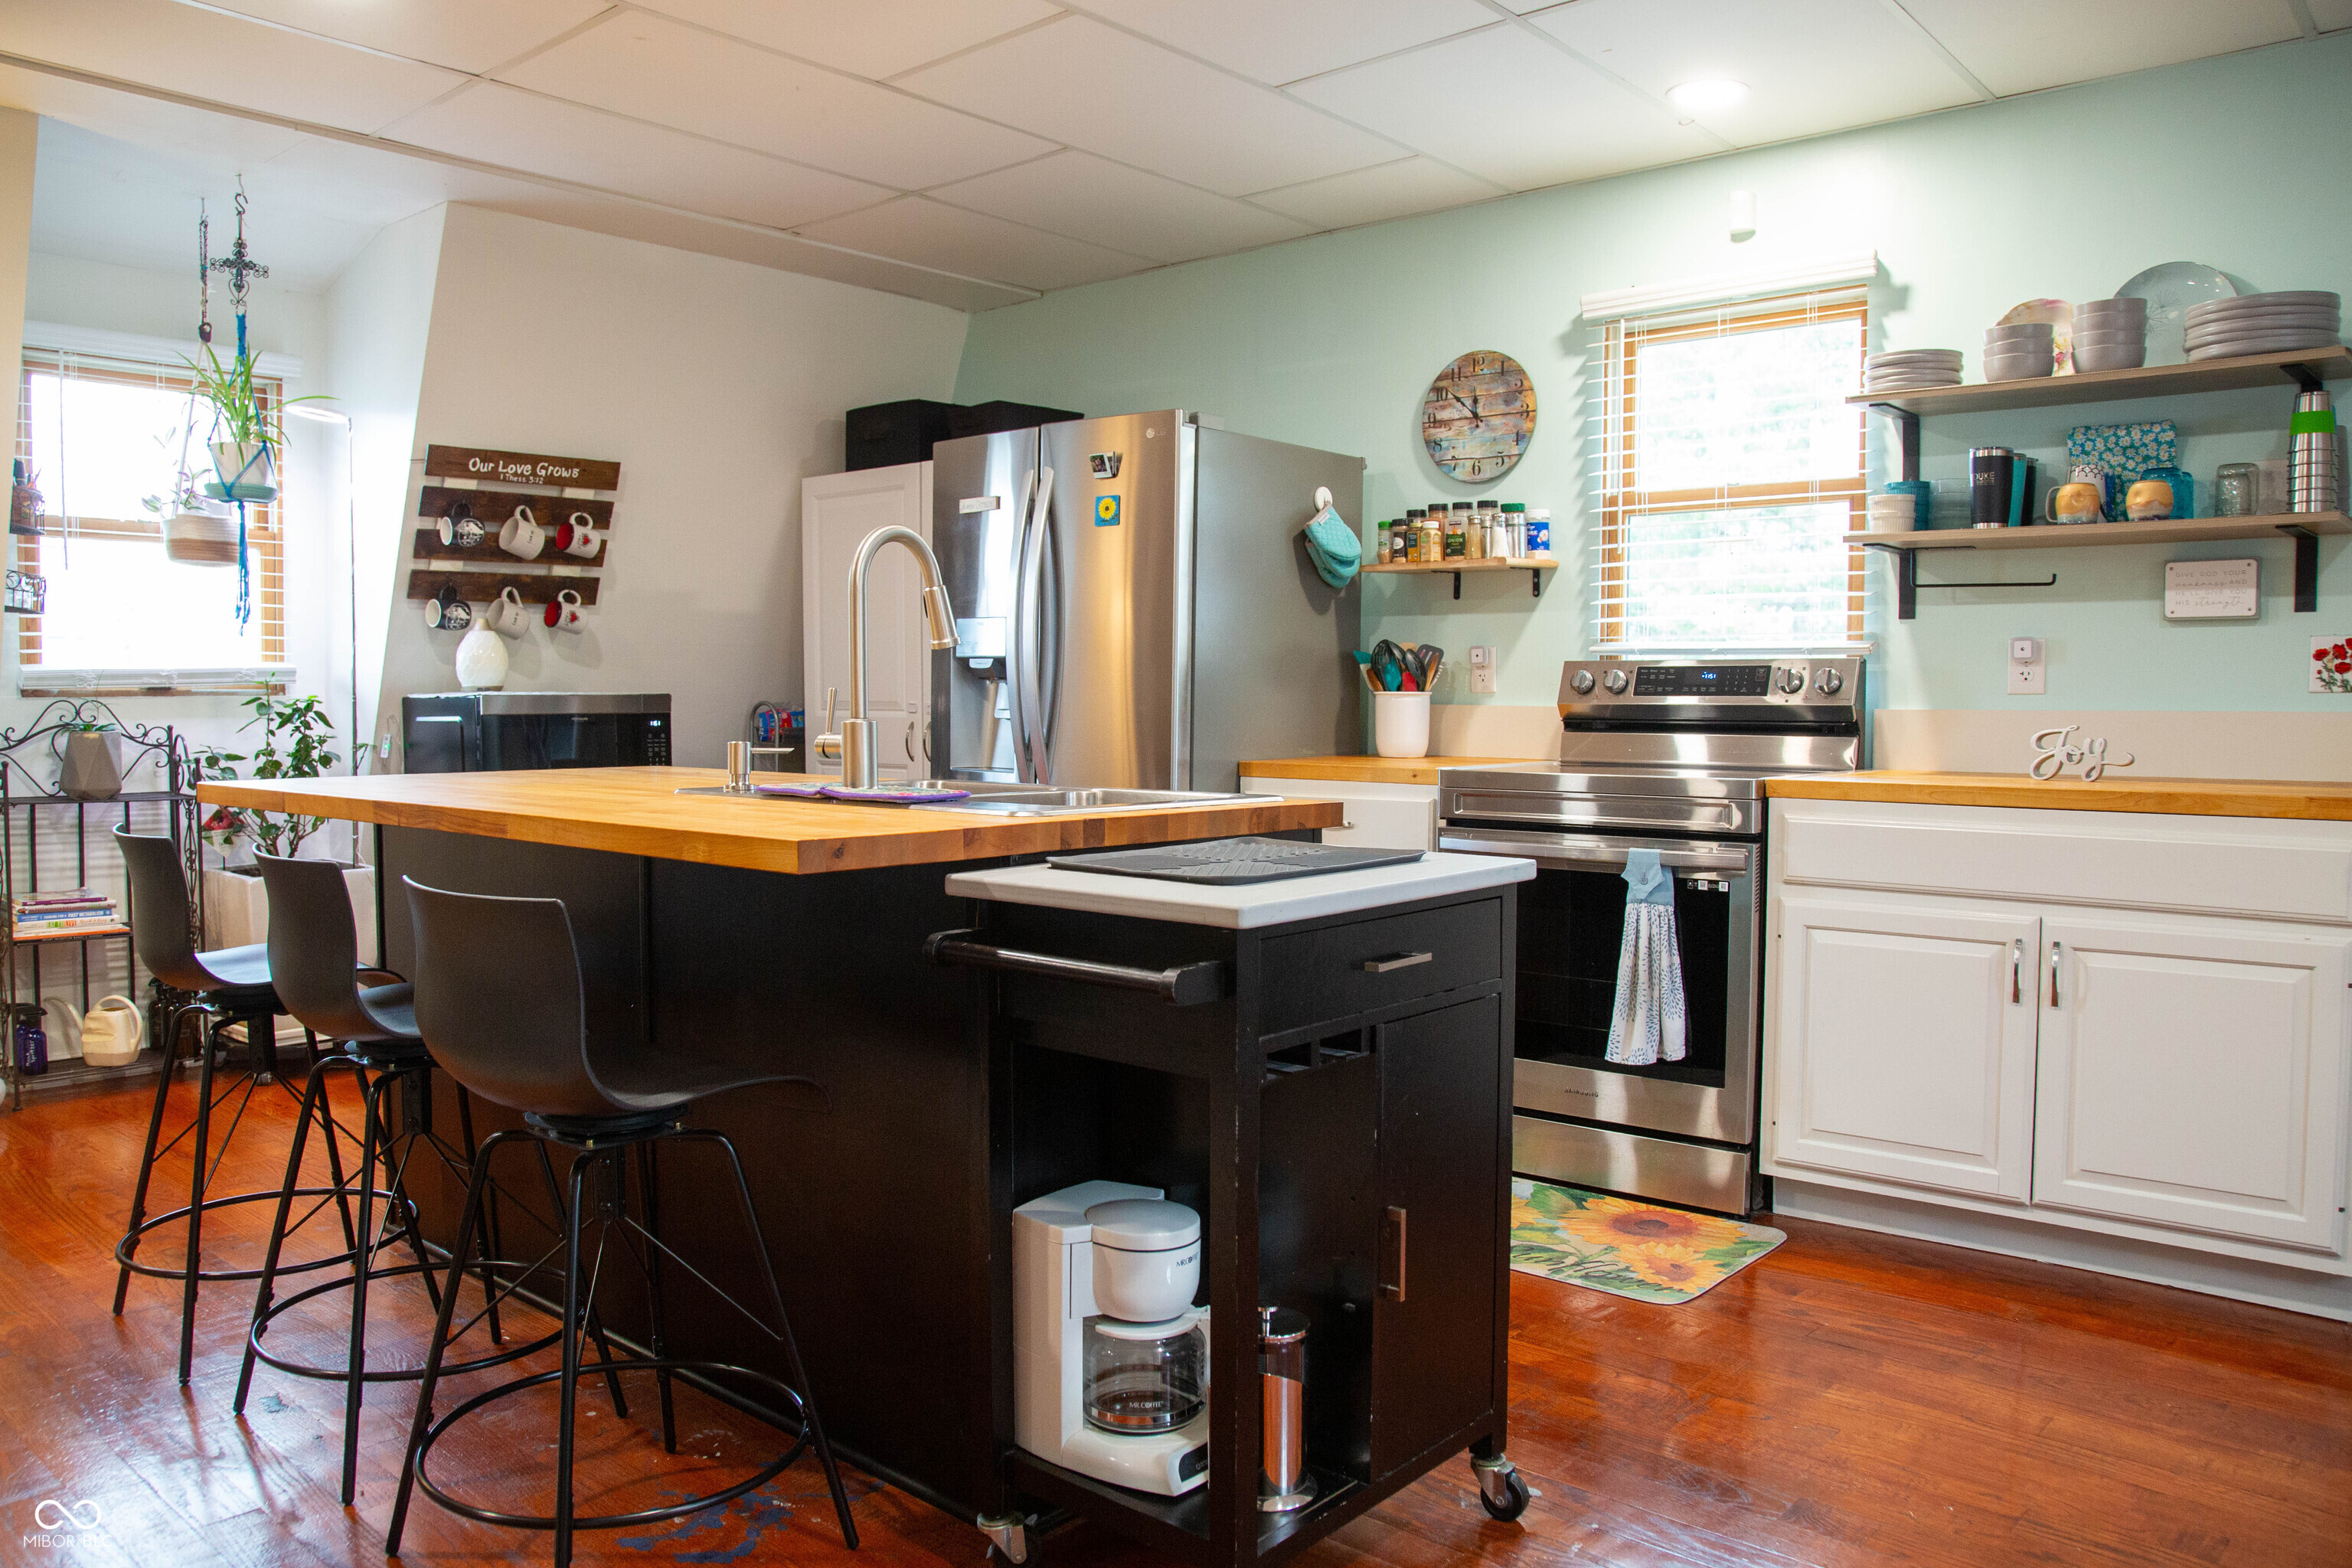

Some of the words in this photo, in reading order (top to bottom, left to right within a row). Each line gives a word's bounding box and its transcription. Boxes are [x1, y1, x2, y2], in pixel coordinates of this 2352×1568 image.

[1472, 356, 1485, 374] 12
[1501, 360, 1505, 376] 1
[1451, 368, 1462, 382] 11
[1514, 378, 1524, 394] 2
[1436, 387, 1449, 402] 10
[1520, 402, 1530, 420] 3
[1428, 413, 1436, 429] 9
[1433, 436, 1442, 452] 8
[1512, 430, 1521, 446] 4
[1451, 456, 1459, 472] 7
[1472, 459, 1481, 475] 6
[1495, 451, 1504, 467] 5
[469, 457, 495, 472] Our
[498, 460, 532, 475] Love
[537, 462, 580, 478] Grows
[528, 476, 544, 485] 3:12
[2030, 725, 2135, 782] Joy
